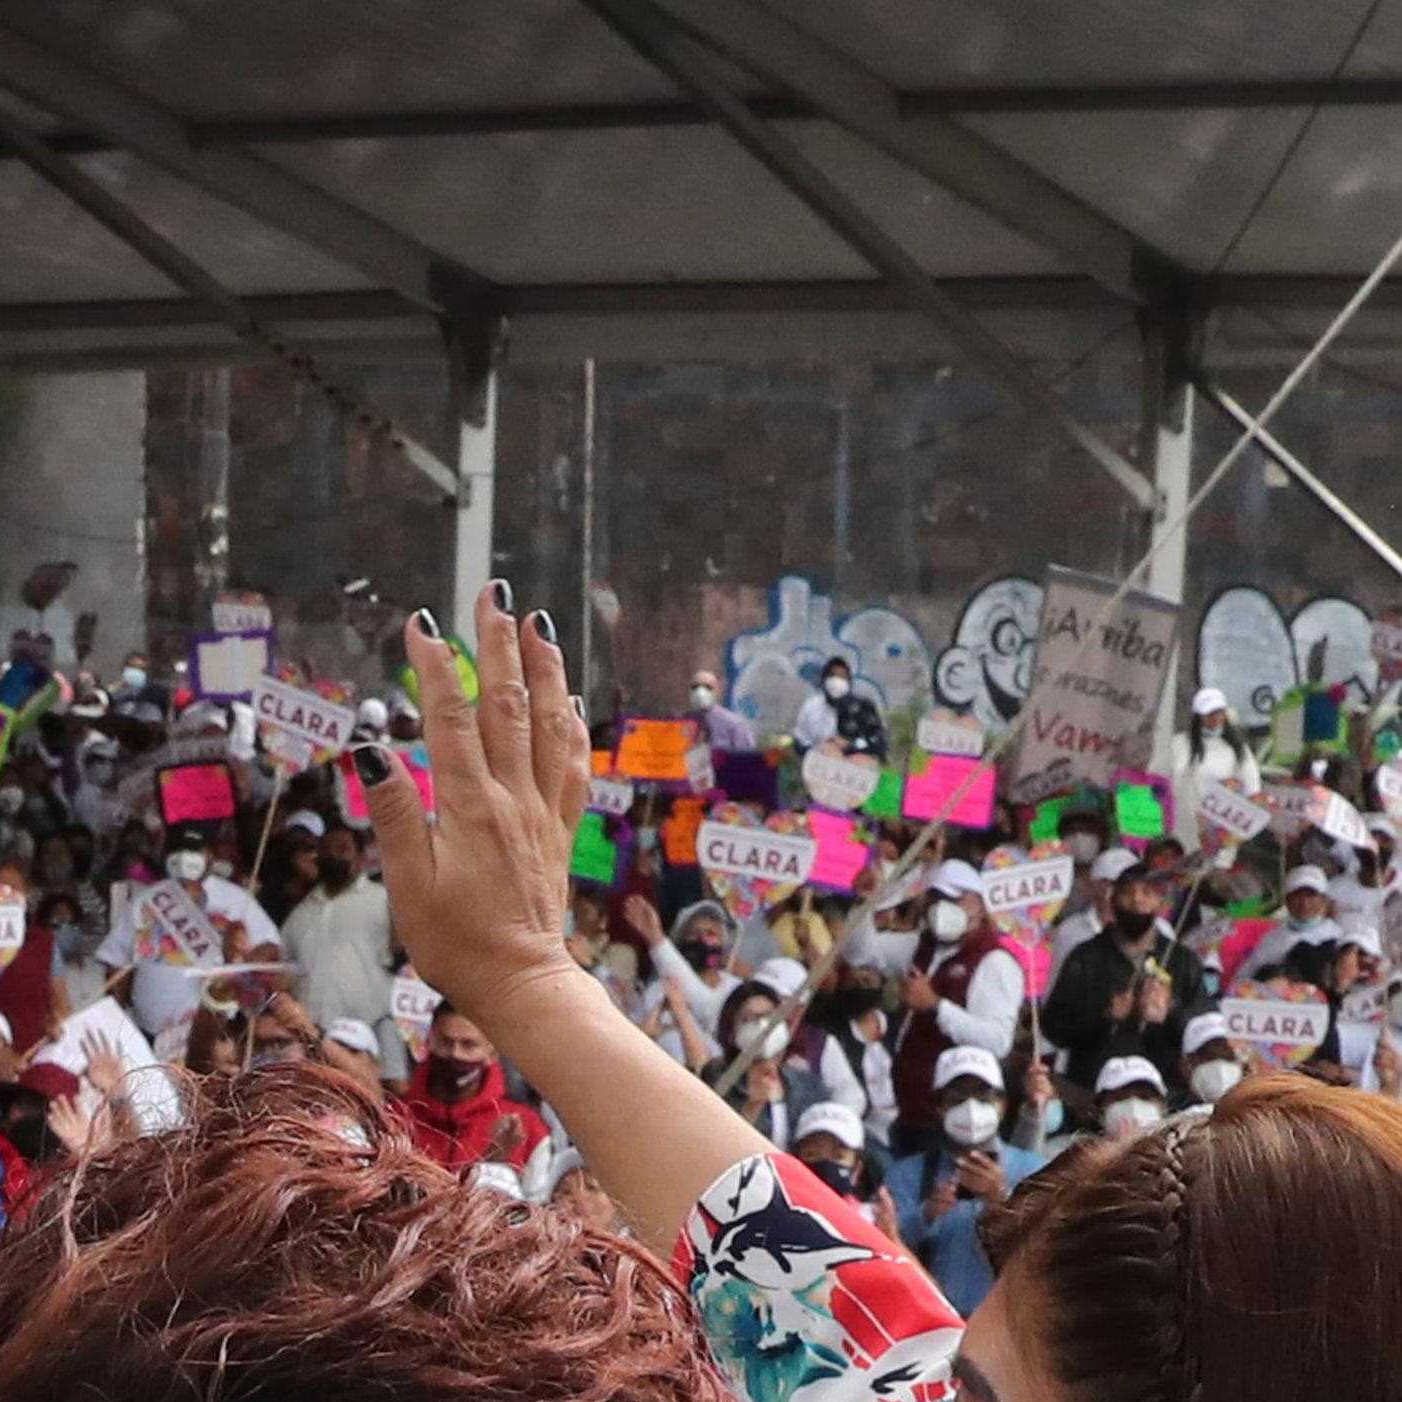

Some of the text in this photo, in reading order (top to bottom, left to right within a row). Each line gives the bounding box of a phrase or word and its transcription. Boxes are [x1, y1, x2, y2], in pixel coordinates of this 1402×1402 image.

[259, 693, 339, 742] CLARA
[707, 839, 801, 877] CLARA
[988, 874, 1063, 906] CLARA
[152, 891, 208, 957] CLARA
[1228, 1013, 1315, 1037] CLARA
